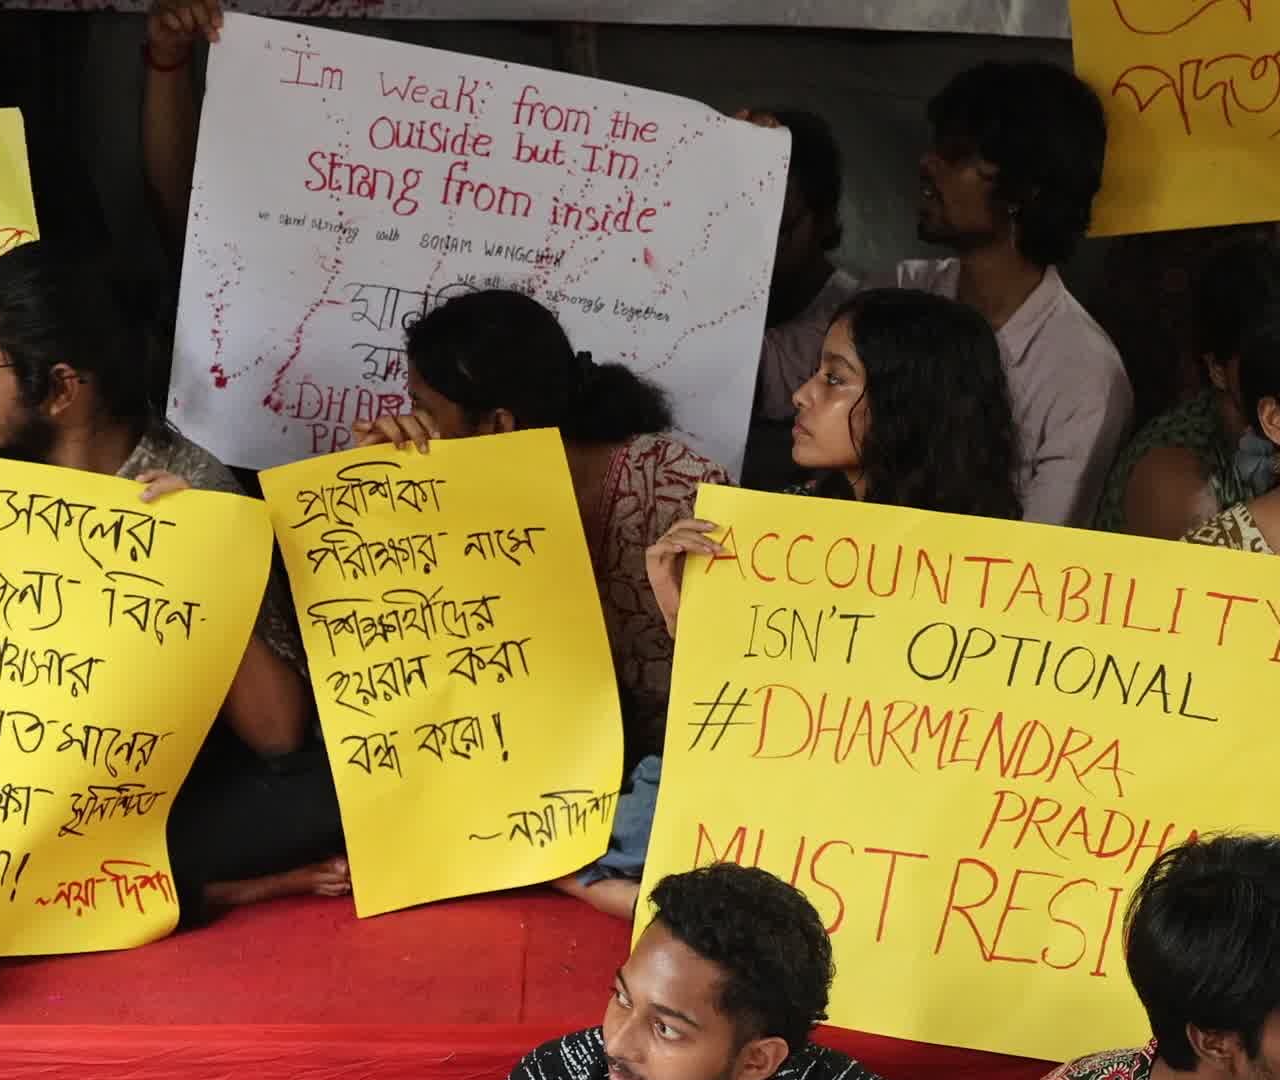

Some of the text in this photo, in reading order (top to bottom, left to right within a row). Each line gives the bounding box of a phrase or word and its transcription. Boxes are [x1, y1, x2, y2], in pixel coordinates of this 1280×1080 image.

[513, 85, 590, 135] from
[611, 110, 658, 143] the
[514, 132, 565, 166] but
[440, 161, 531, 217] from
[306, 527, 546, 581] পরীক্ষার নামে
[446, 638, 532, 685] করা
[743, 603, 1219, 722] ISN'T OPTIONAL
[56, 723, 174, 778] মানের
[340, 730, 399, 778] বন্ধ
[687, 680, 1136, 797] #DHARMENDRA
[933, 857, 1124, 977] RESI
